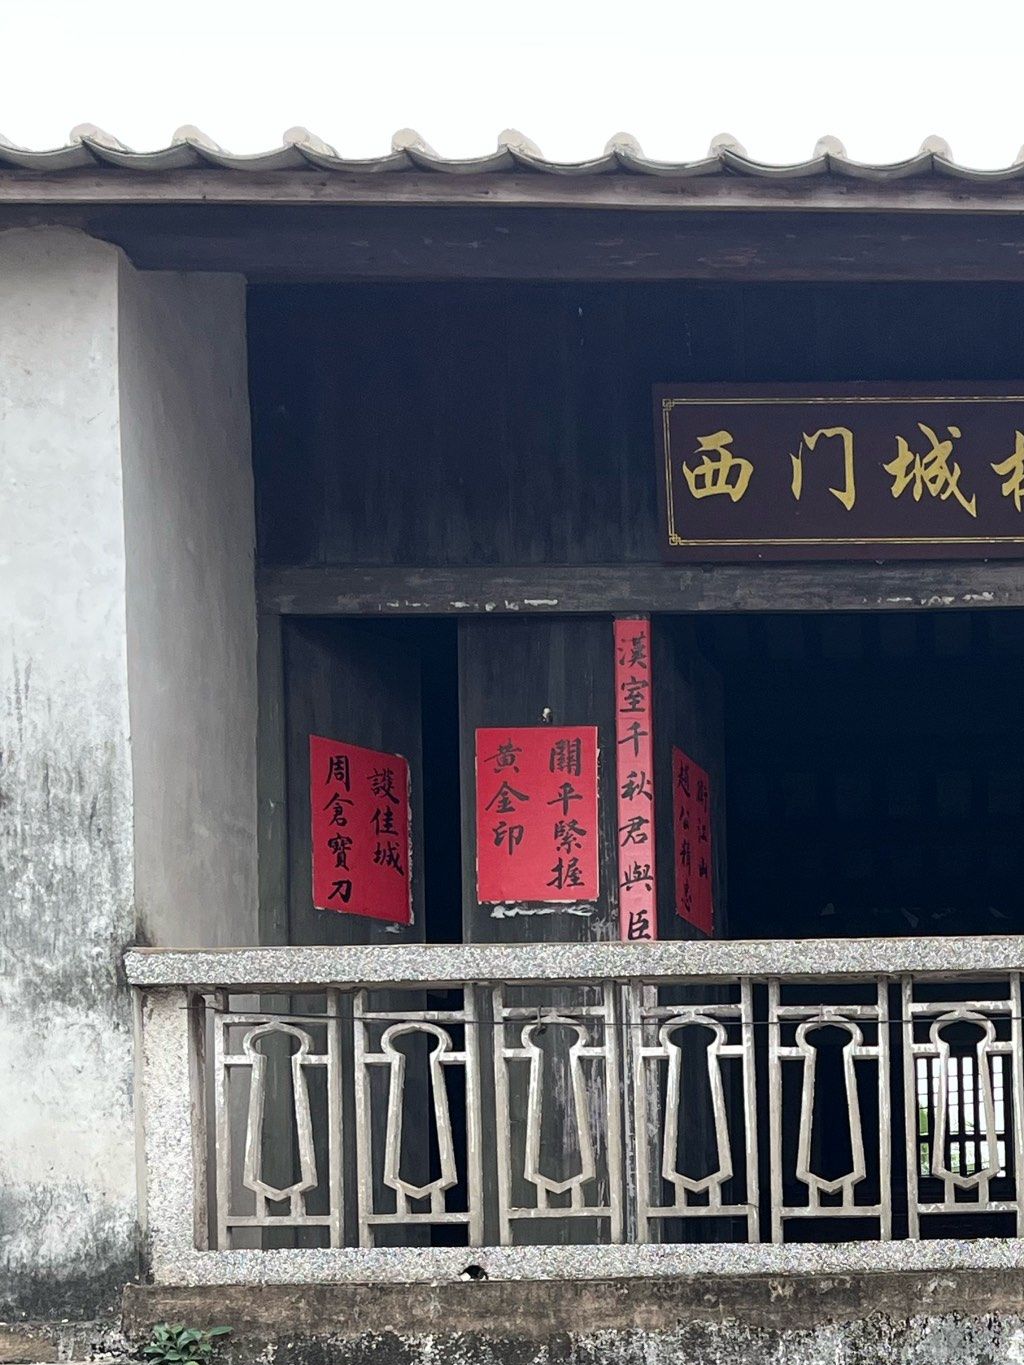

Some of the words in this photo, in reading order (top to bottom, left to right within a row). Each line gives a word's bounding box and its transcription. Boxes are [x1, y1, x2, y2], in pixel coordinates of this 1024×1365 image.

[323, 755, 354, 903] 周倉寶刀
[546, 737, 586, 890] 關平緊握
[617, 632, 654, 941] 漢室千秋君與臣
